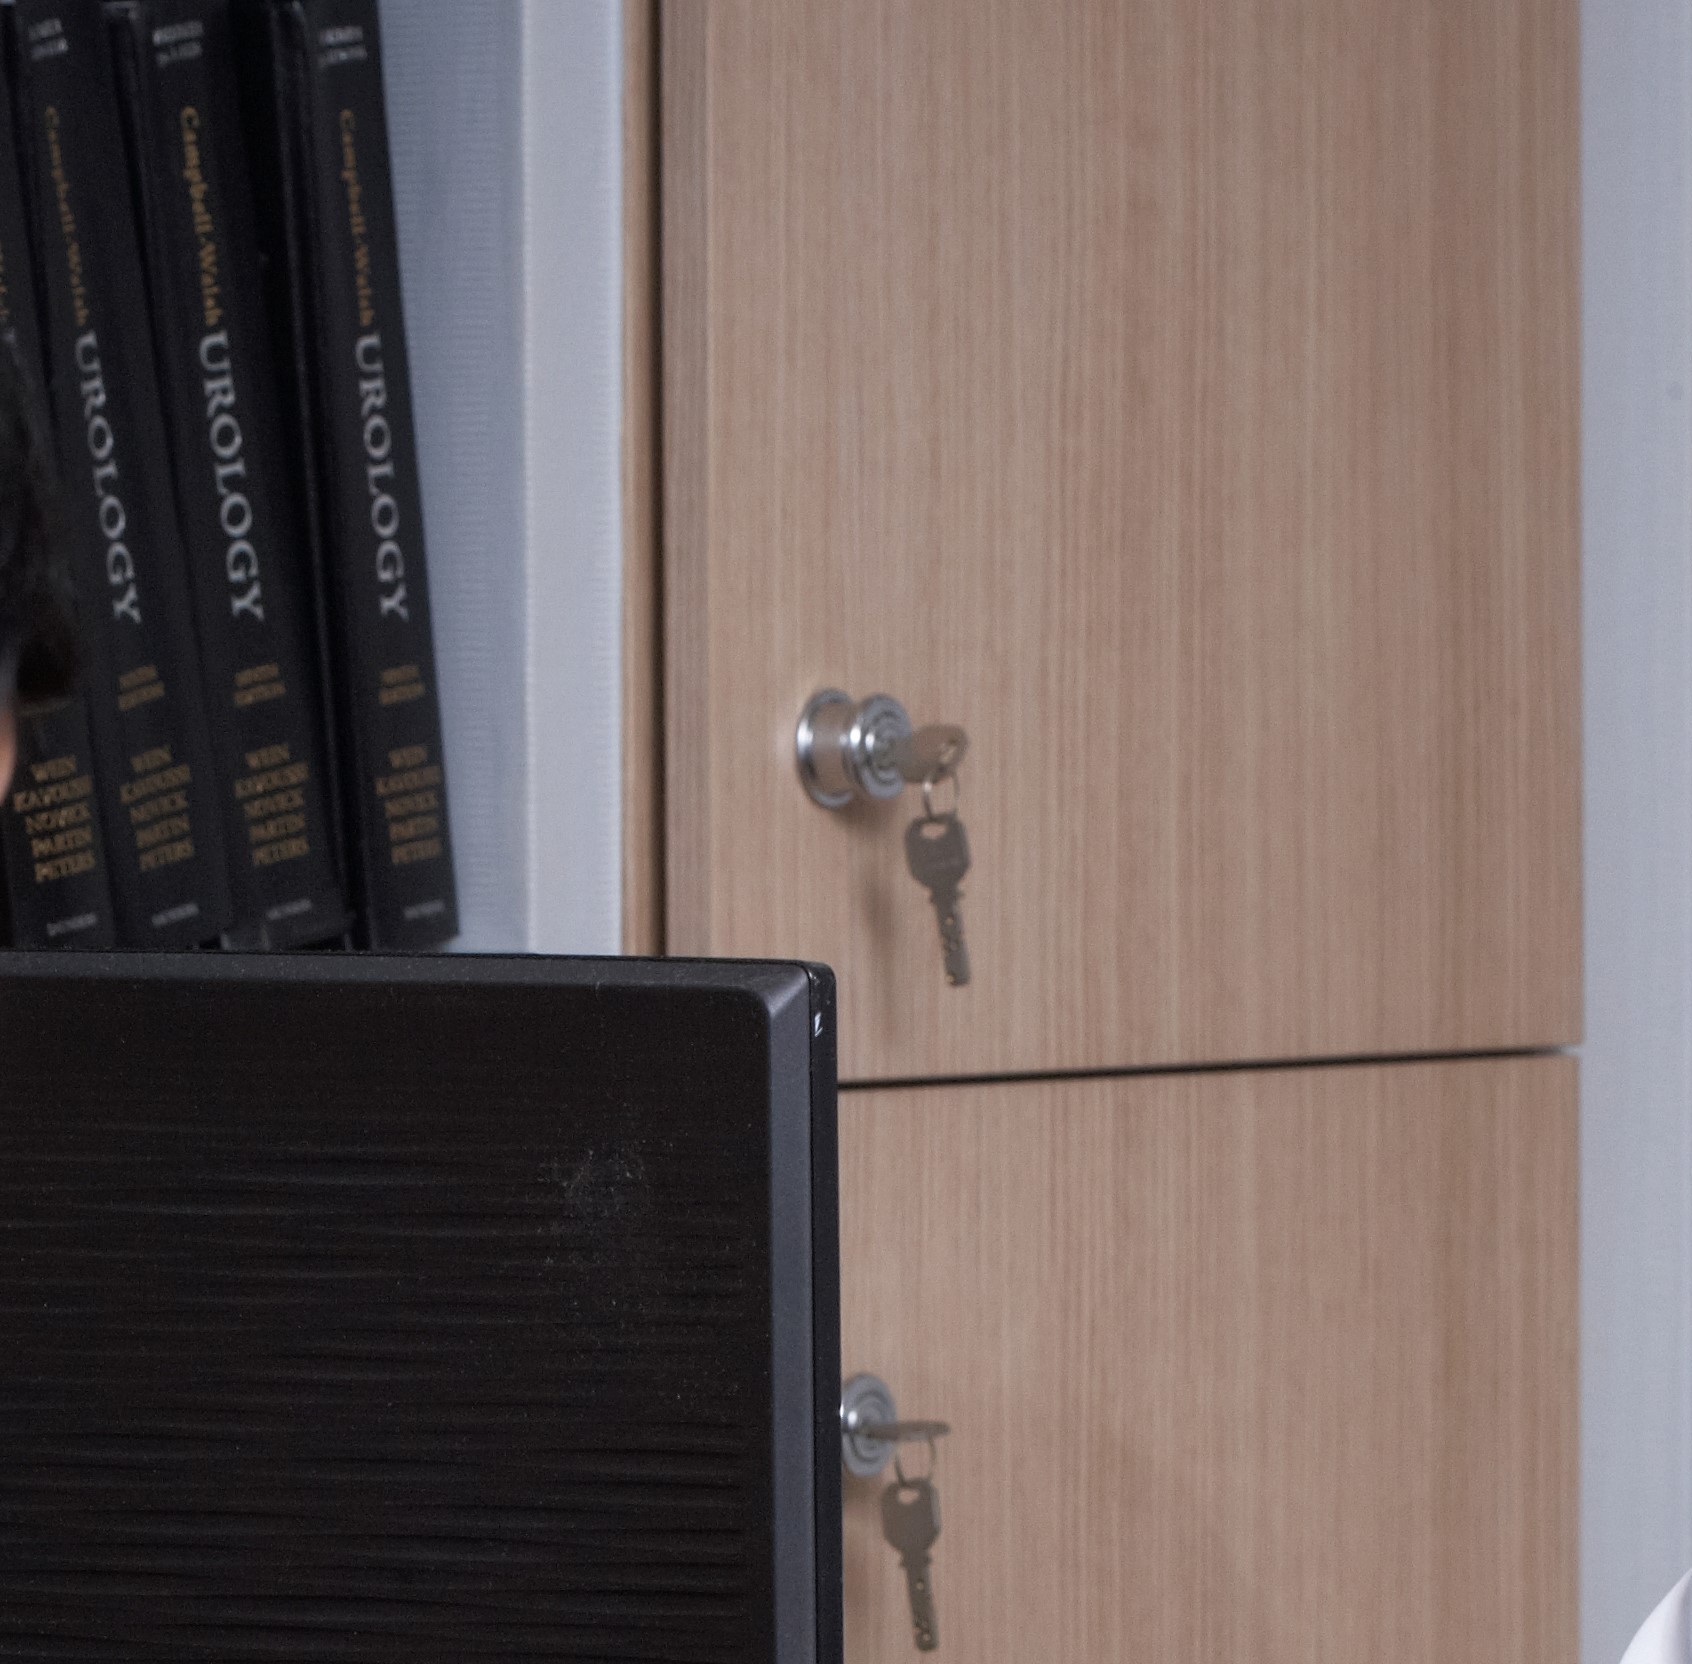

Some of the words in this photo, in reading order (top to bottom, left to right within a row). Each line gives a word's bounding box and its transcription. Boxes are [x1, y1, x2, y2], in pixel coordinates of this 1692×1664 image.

[75, 331, 141, 623] UROLOGY
[199, 331, 264, 622] UROLOGY
[354, 333, 408, 623] UROLOGY
